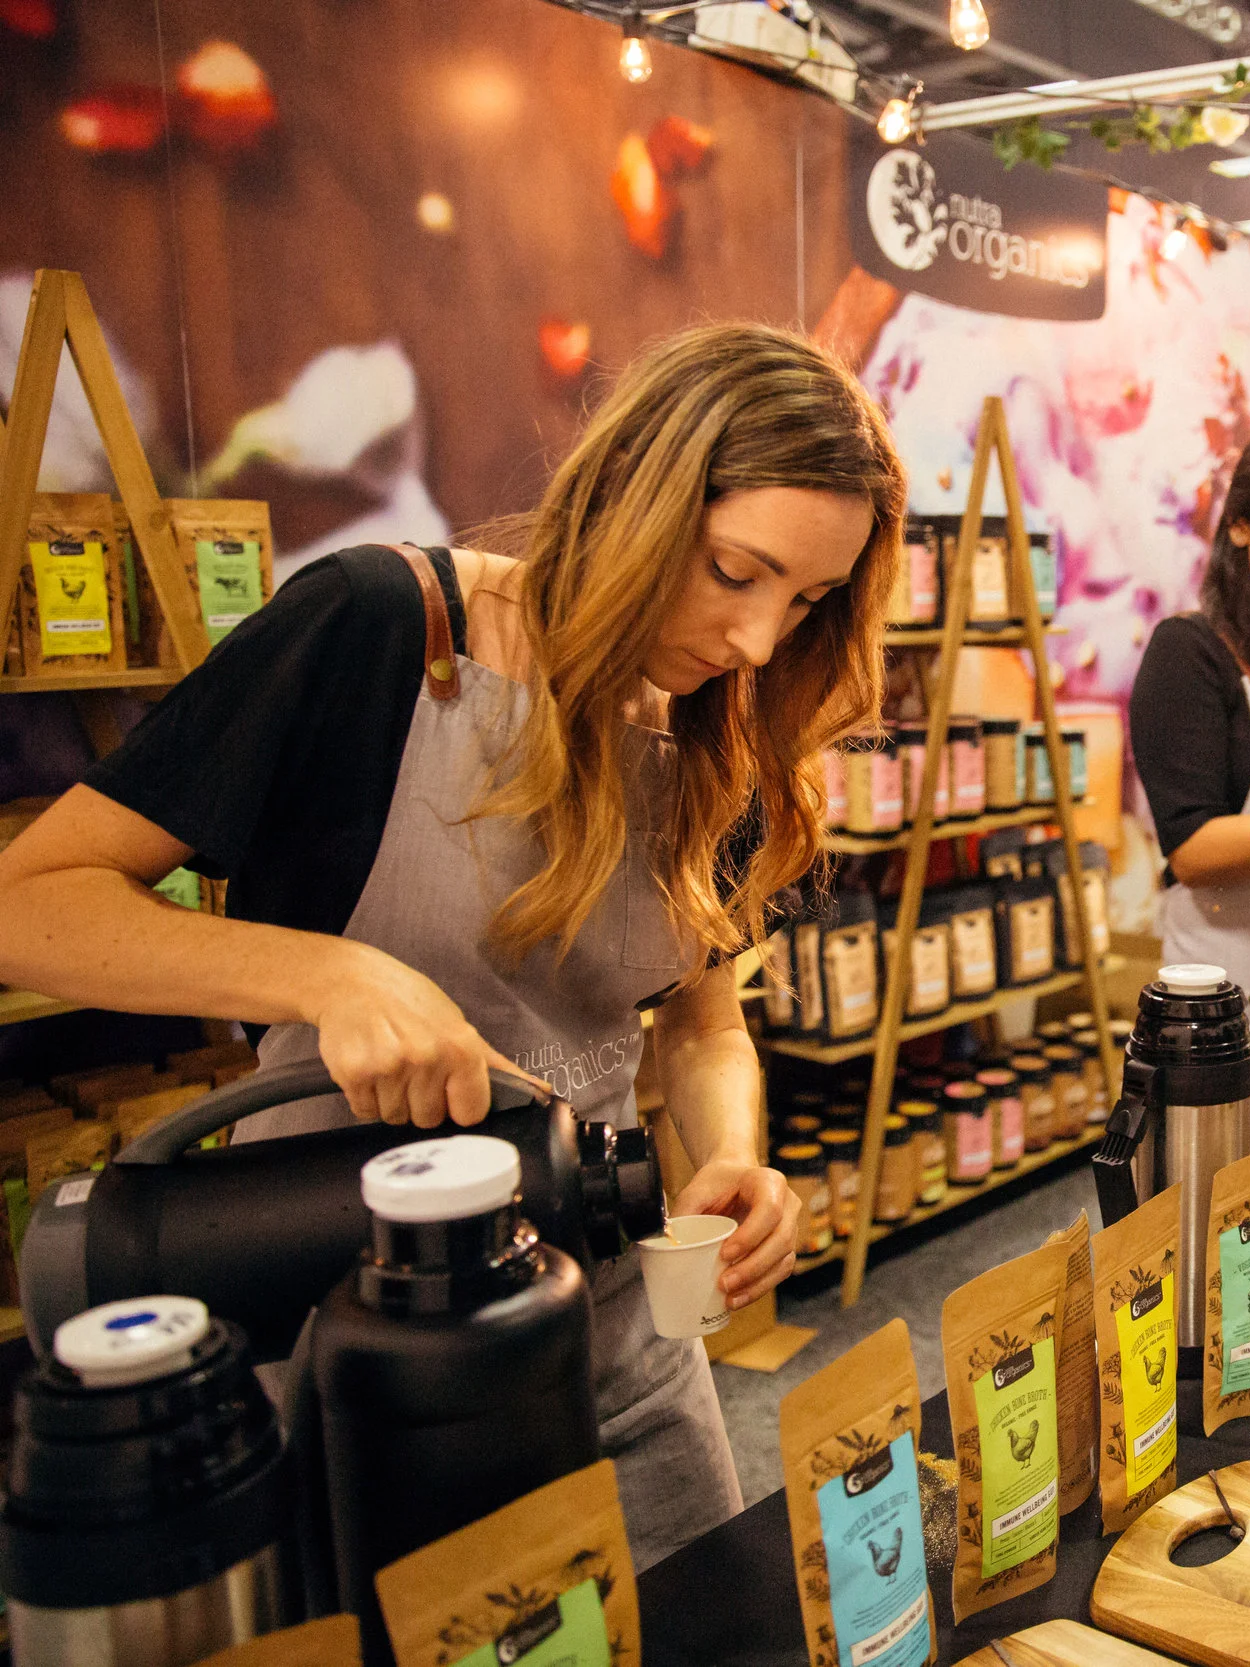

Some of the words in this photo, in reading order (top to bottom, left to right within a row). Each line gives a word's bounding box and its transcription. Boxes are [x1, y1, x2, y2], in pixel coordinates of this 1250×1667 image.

[949, 192, 1002, 228] nutra
[531, 1037, 627, 1102] rganics
[999, 1511, 1021, 1530] IMMUNE
[1022, 1493, 1048, 1517] WELLBEING
